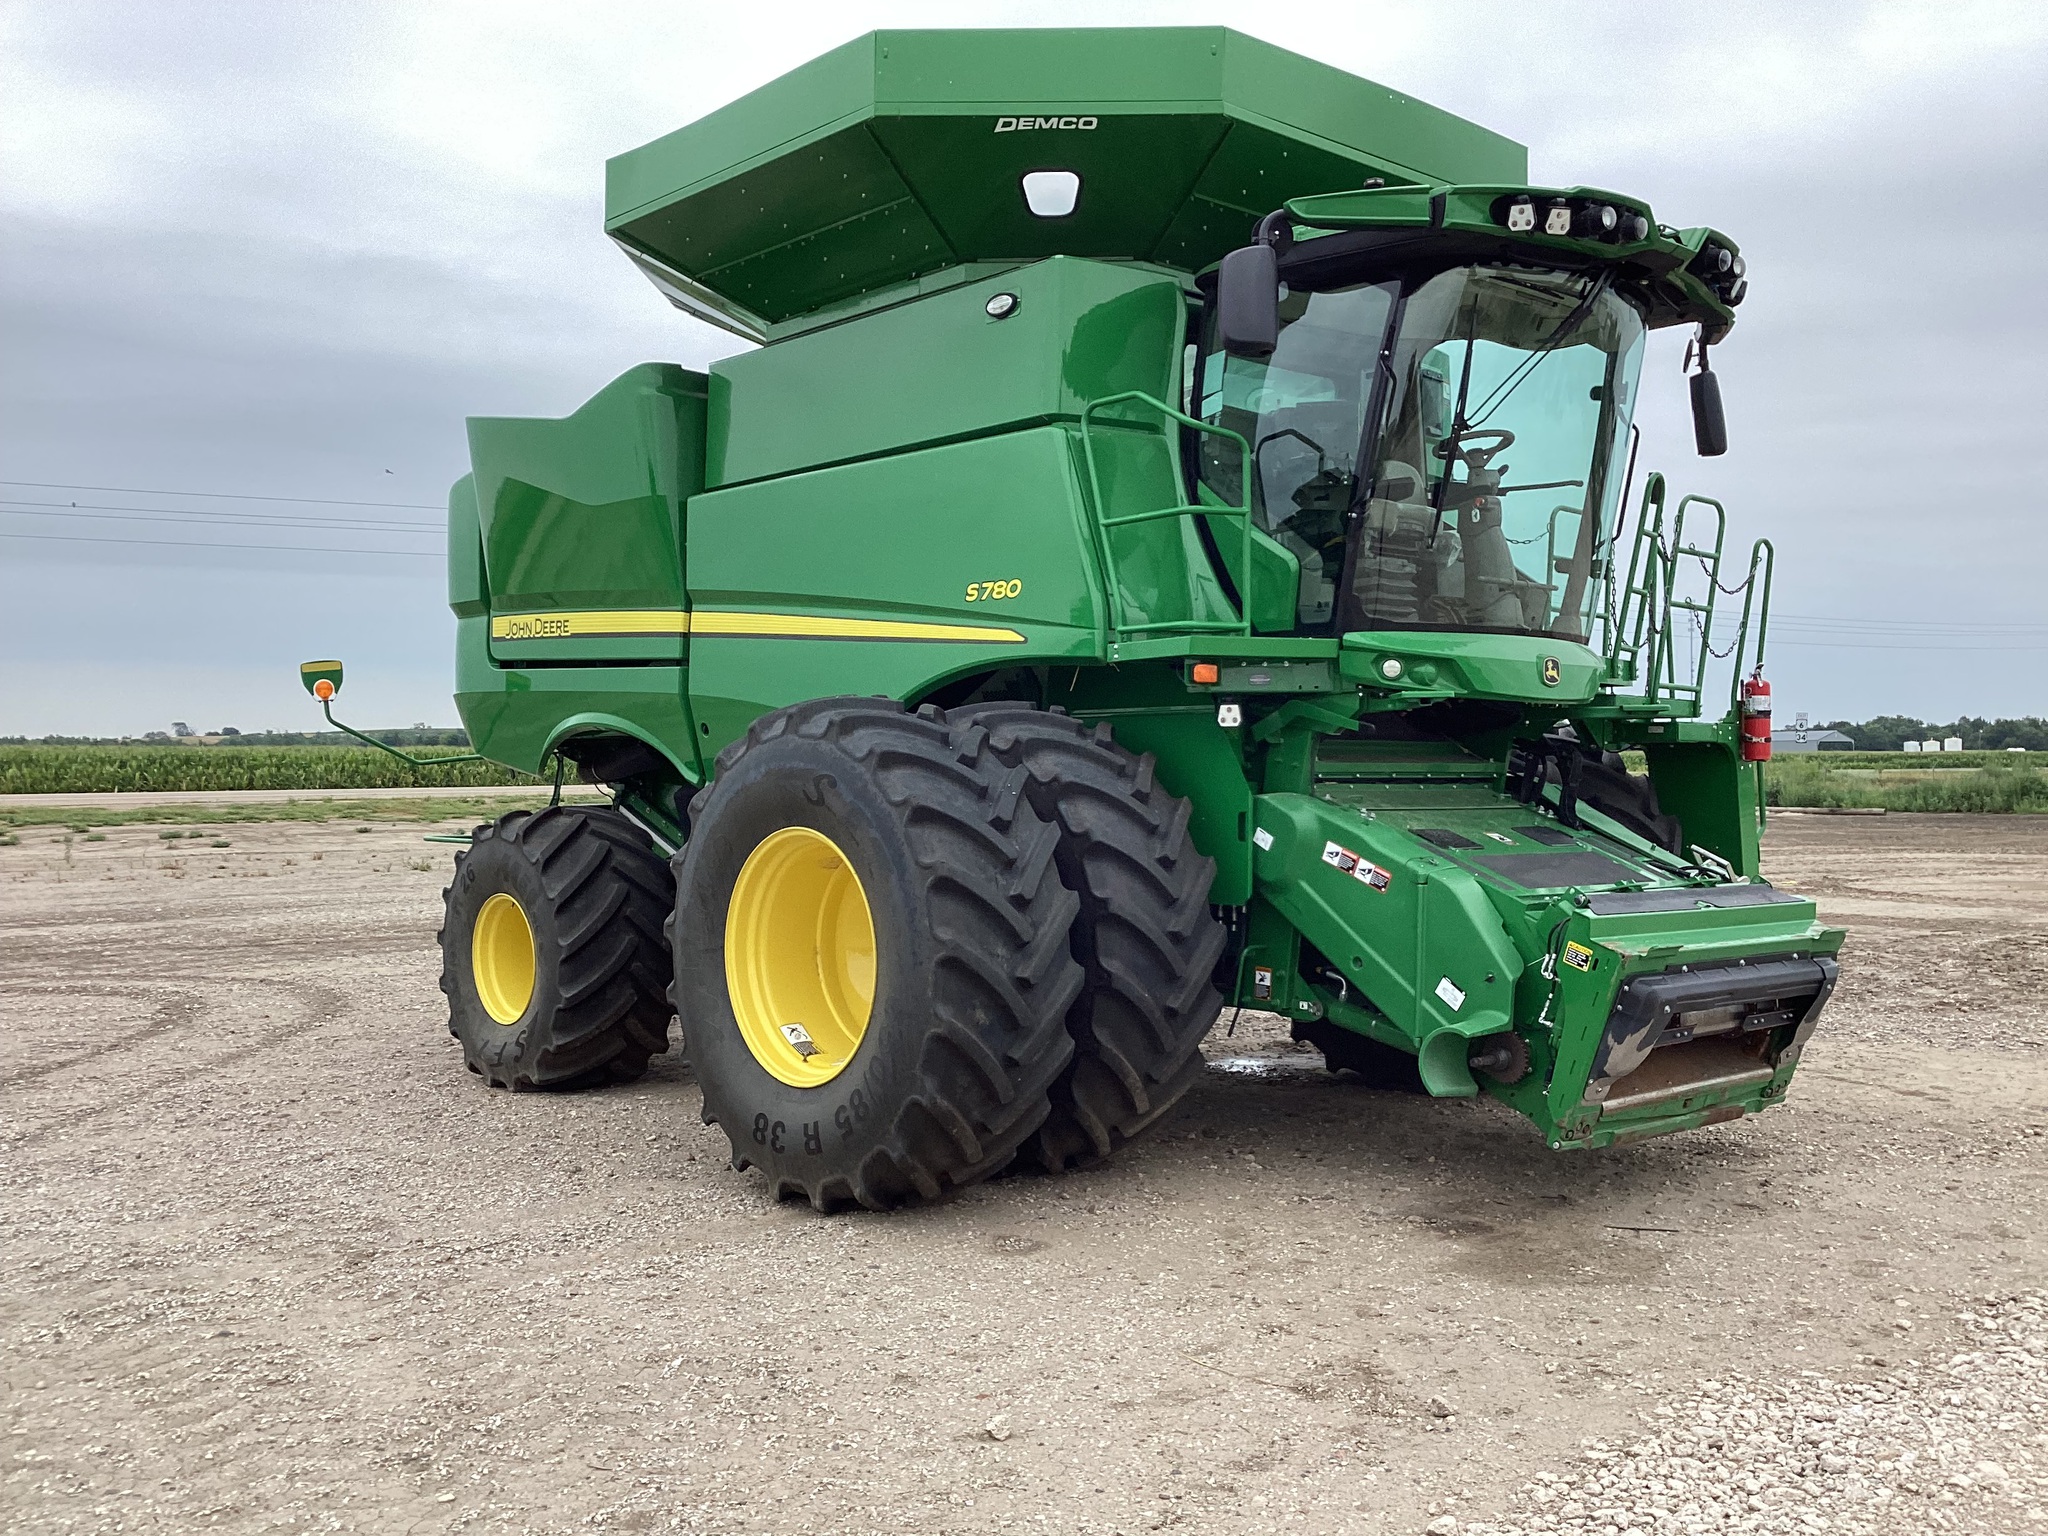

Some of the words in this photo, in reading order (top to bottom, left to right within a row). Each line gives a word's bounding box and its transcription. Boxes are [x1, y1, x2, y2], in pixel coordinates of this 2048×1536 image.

[993, 116, 1098, 133] DEMCO
[964, 578, 1023, 603] S780
[505, 619, 533, 637] JOHN
[534, 618, 570, 635] DEERE
[1796, 733, 1806, 741] 34
[752, 1112, 787, 1155] 38
[803, 1120, 824, 1157] R
